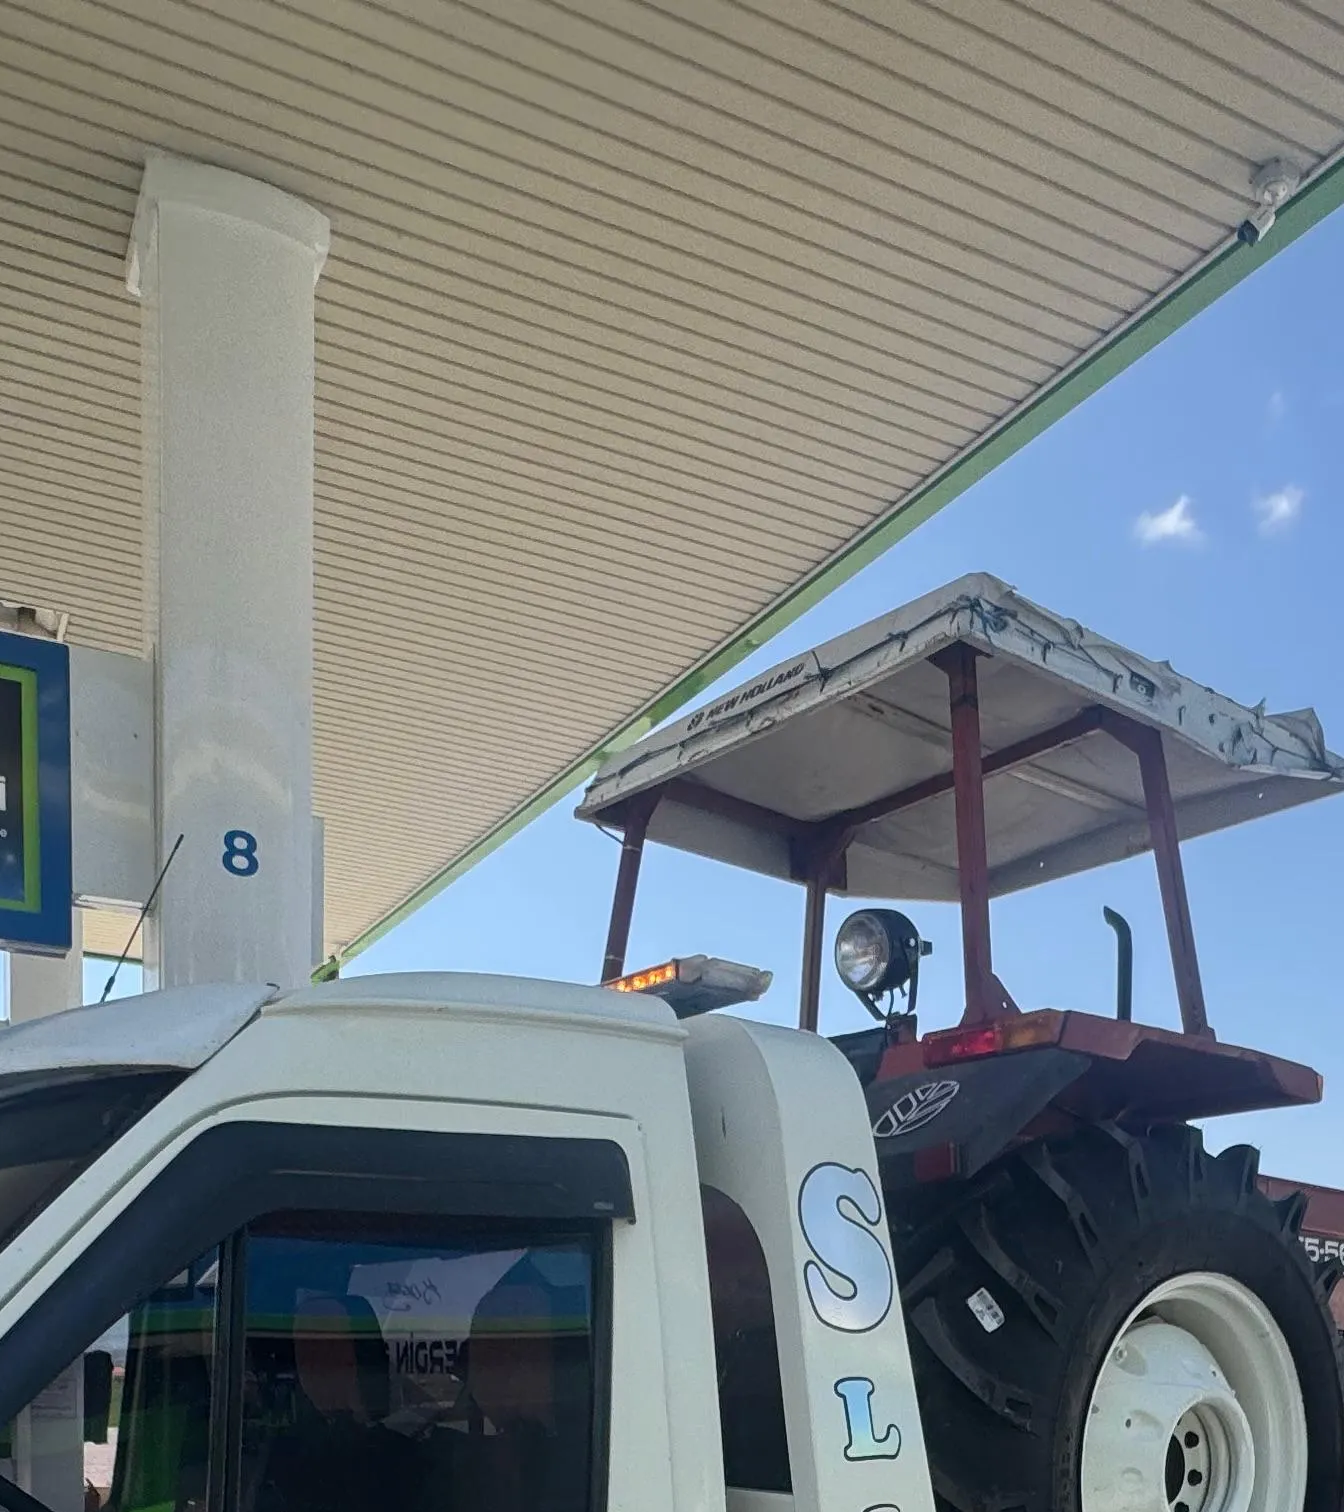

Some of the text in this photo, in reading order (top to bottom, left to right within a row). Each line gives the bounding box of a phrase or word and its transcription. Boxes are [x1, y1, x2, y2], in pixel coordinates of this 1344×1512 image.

[706, 662, 805, 719] NEW HOLLAND
[222, 829, 259, 877] 8
